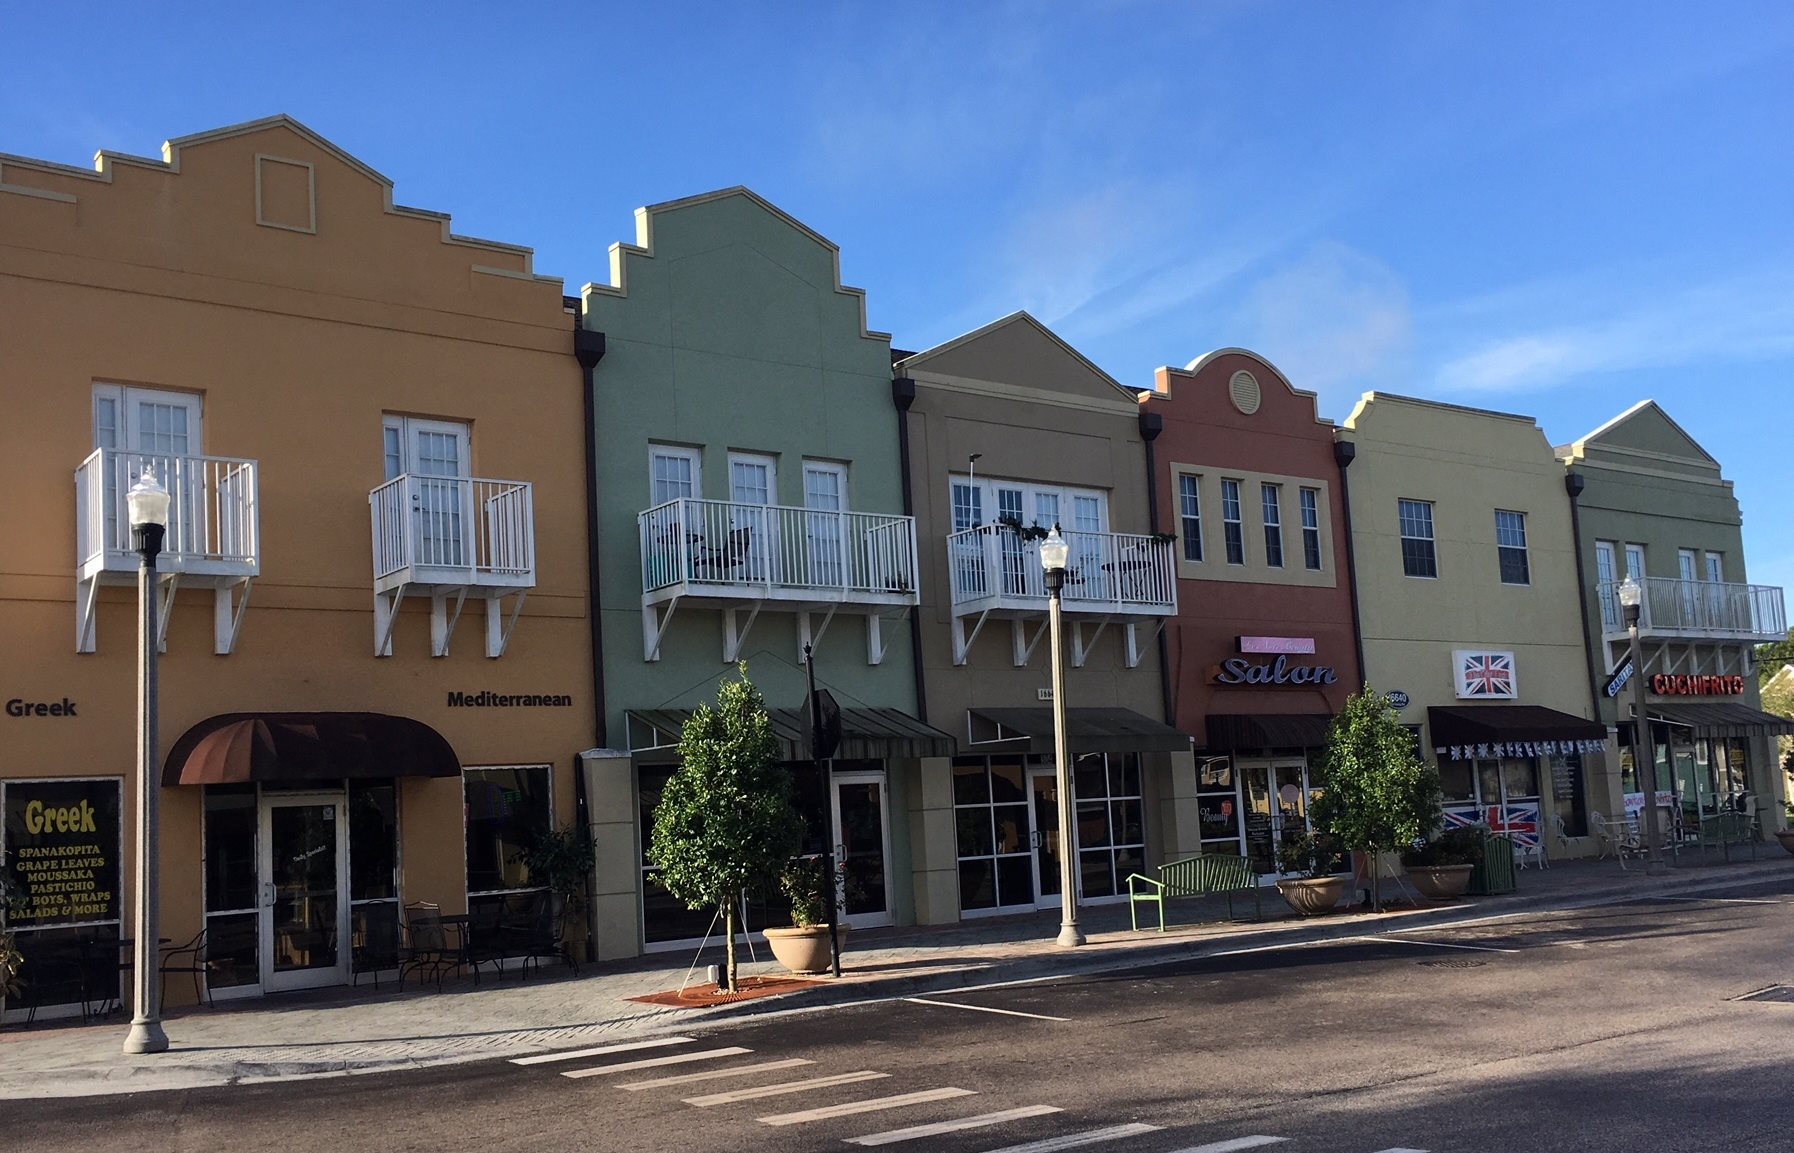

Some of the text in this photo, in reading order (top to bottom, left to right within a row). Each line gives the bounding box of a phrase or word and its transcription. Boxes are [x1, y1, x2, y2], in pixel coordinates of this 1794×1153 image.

[1217, 655, 1338, 685] Salon
[1607, 661, 1634, 694] SARITA
[1653, 673, 1744, 695] CUCHIFRITO
[448, 691, 572, 707] Mediterranean
[1386, 692, 1406, 703] 6640
[6, 698, 77, 716] Greek
[25, 799, 97, 835] Greek
[18, 844, 101, 858] SPANAKOPITA
[16, 857, 105, 872] GRAPE LEAVES
[27, 870, 94, 882] MOUSSAKA
[30, 881, 95, 894] PASTICHIO
[32, 894, 68, 906] BOYS,
[70, 891, 111, 903] WRAPS
[9, 903, 108, 920] SALADS & MORE
